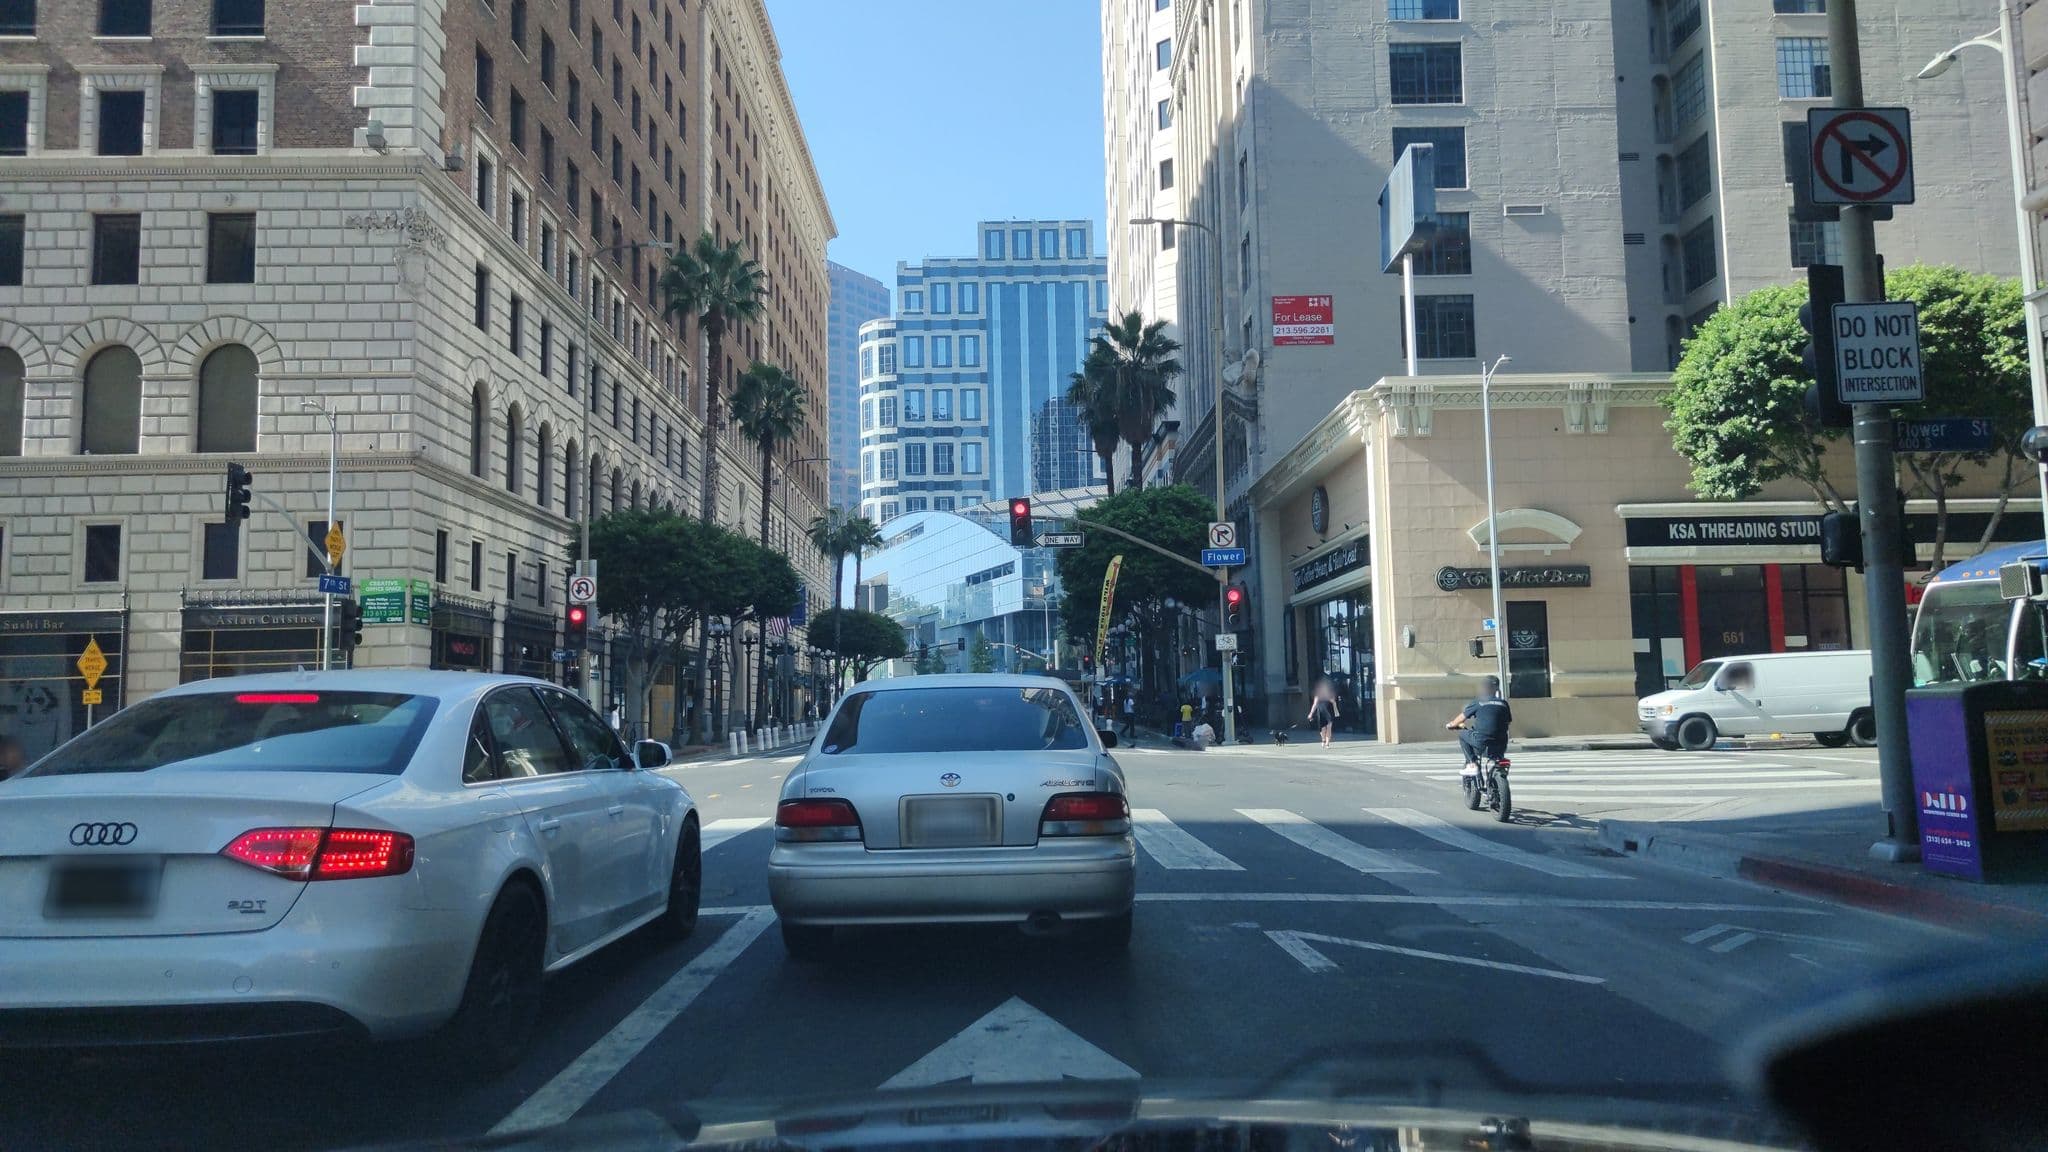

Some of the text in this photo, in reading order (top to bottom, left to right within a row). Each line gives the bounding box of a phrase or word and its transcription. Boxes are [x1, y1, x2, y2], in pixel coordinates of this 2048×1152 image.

[1274, 312, 1322, 322] For Lease
[1839, 315, 1912, 338] DO NOT
[1844, 347, 1914, 370] BLOCK
[1845, 376, 1917, 393] INTERSECTION
[1897, 420, 1989, 437] Flower St
[1668, 521, 1821, 539] KSA THREADING STUDI
[1044, 535, 1079, 544] ONE WAY
[1207, 552, 1241, 561] Flower
[338, 581, 348, 591] St
[3, 619, 64, 630] Sushi Bar
[216, 614, 317, 625] Asian Cuisine
[1723, 631, 1745, 644] 661
